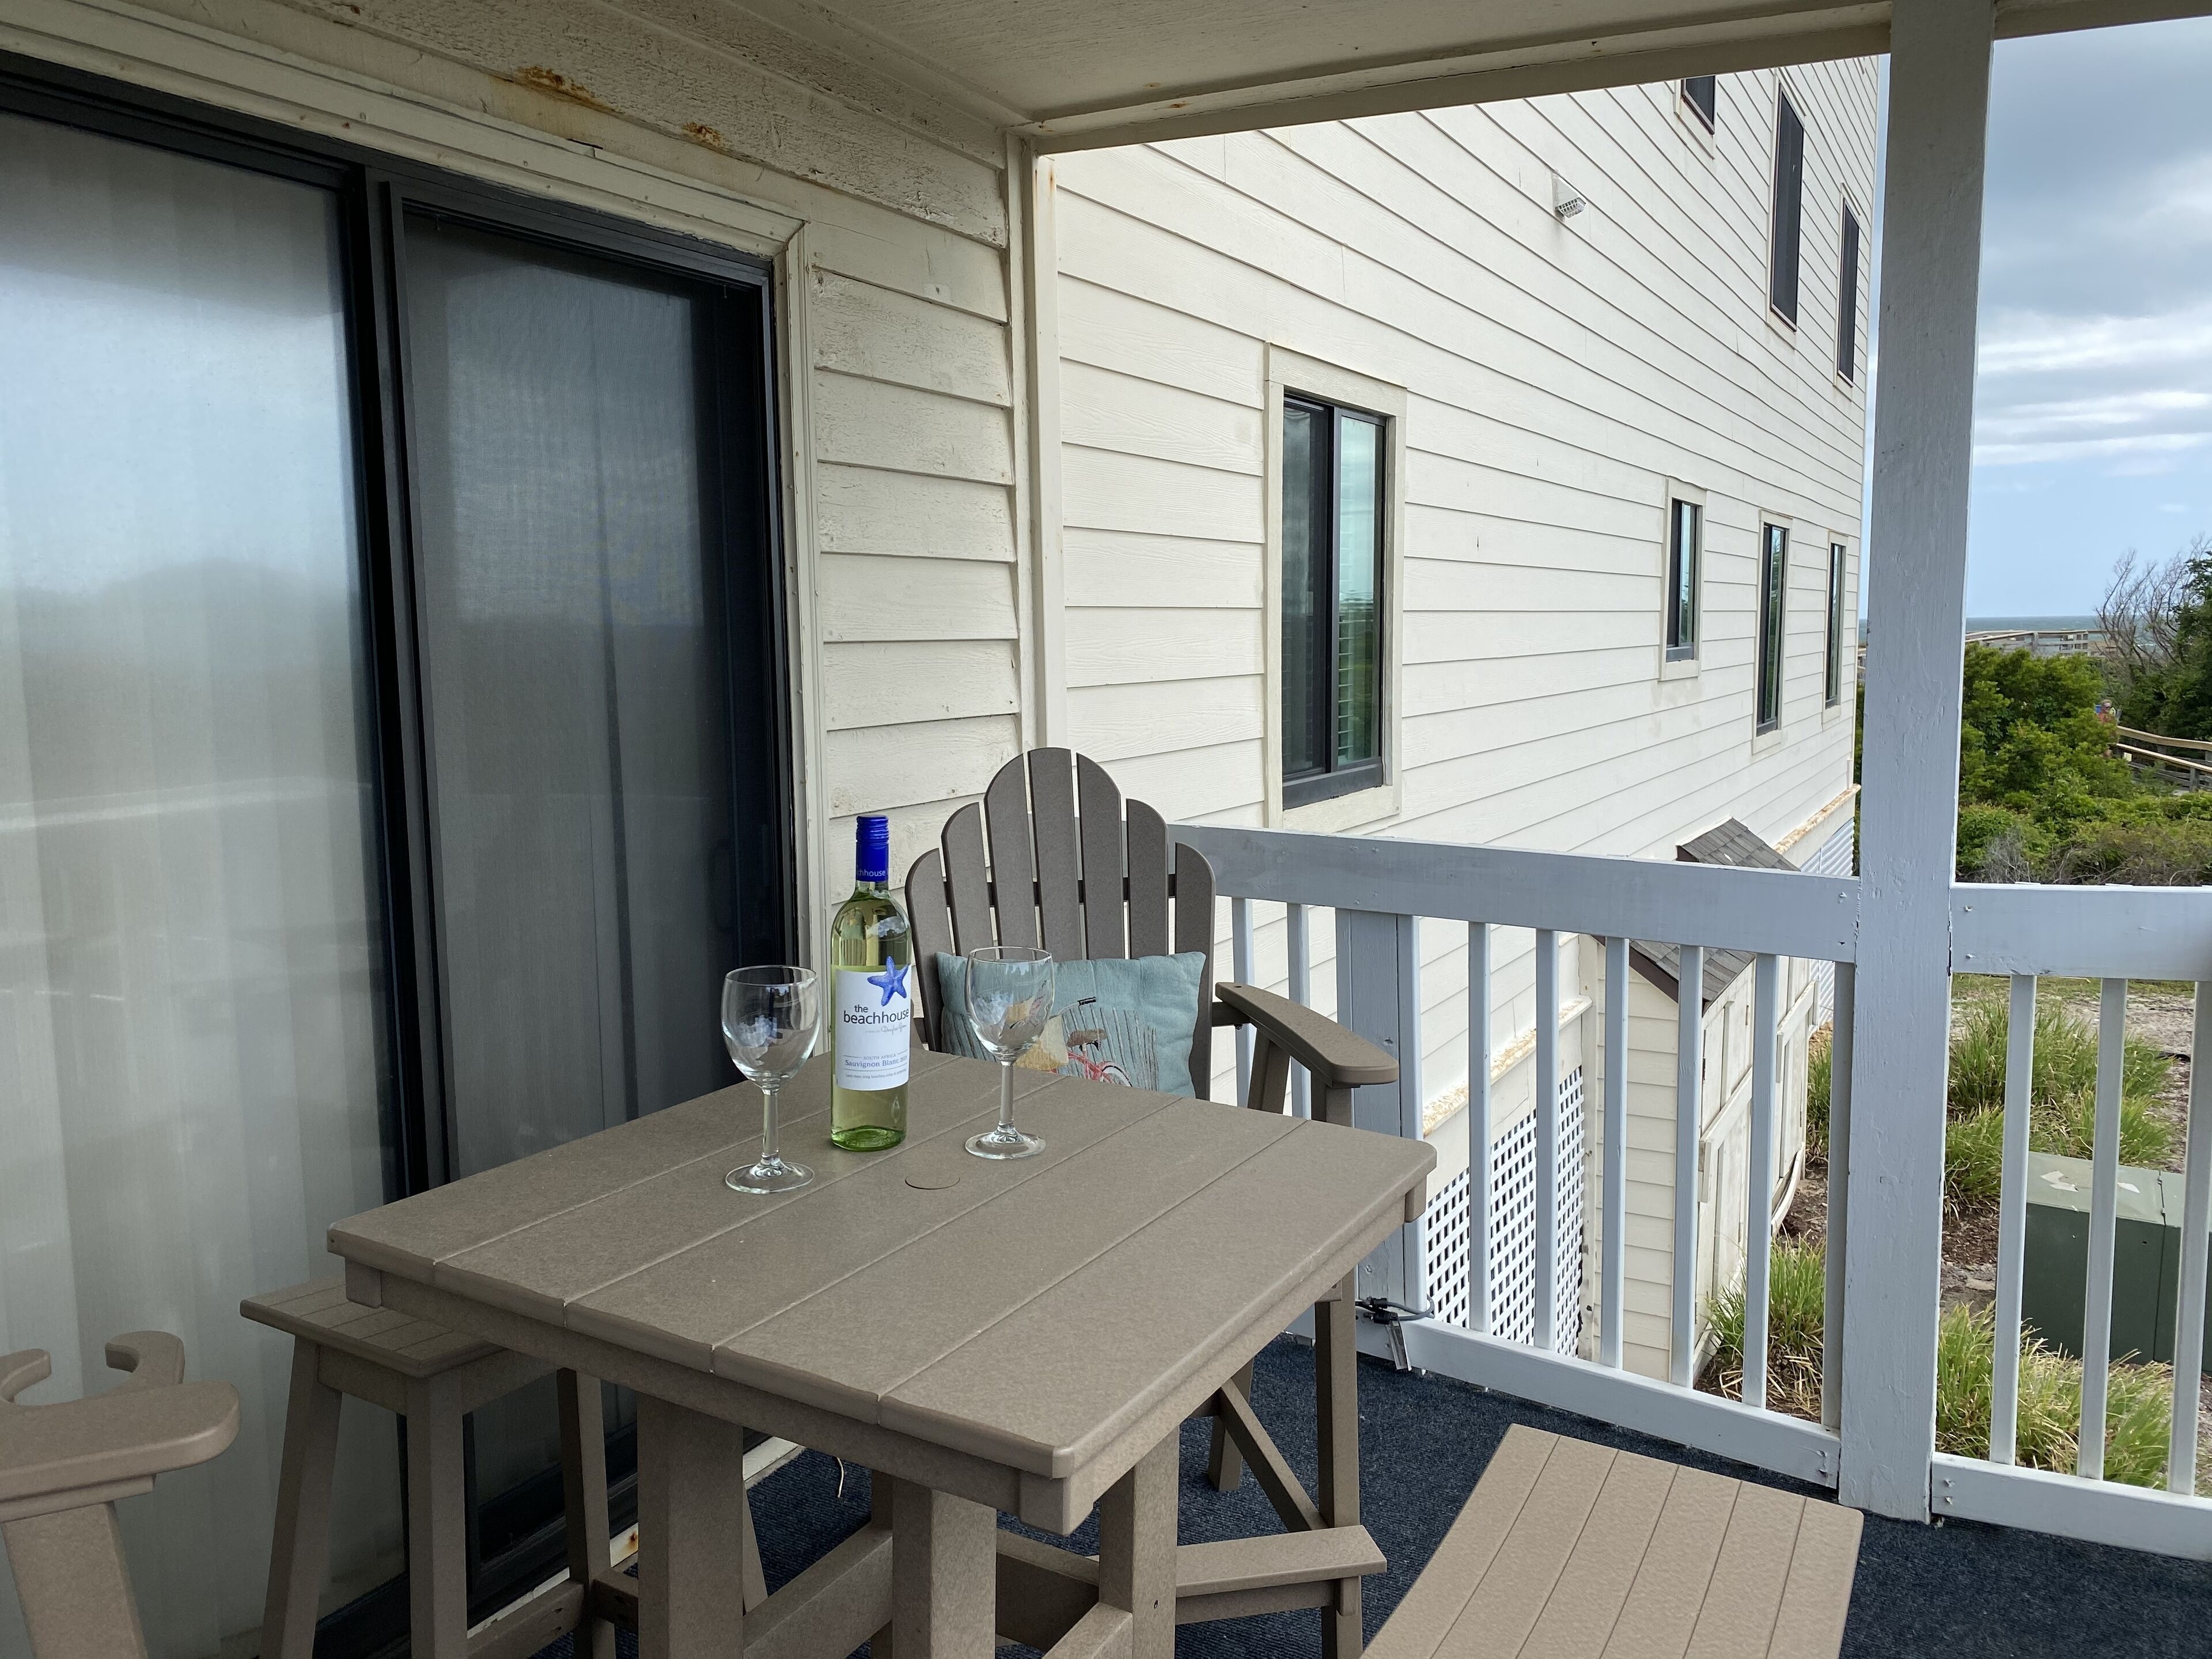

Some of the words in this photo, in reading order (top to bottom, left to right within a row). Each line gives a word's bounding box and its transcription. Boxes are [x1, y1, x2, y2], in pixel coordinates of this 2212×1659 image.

[854, 1004, 869, 1013] the
[843, 1008, 909, 1024] beachhouse
[844, 1059, 880, 1069] Sauvignon
[882, 1058, 899, 1066] Blanc
